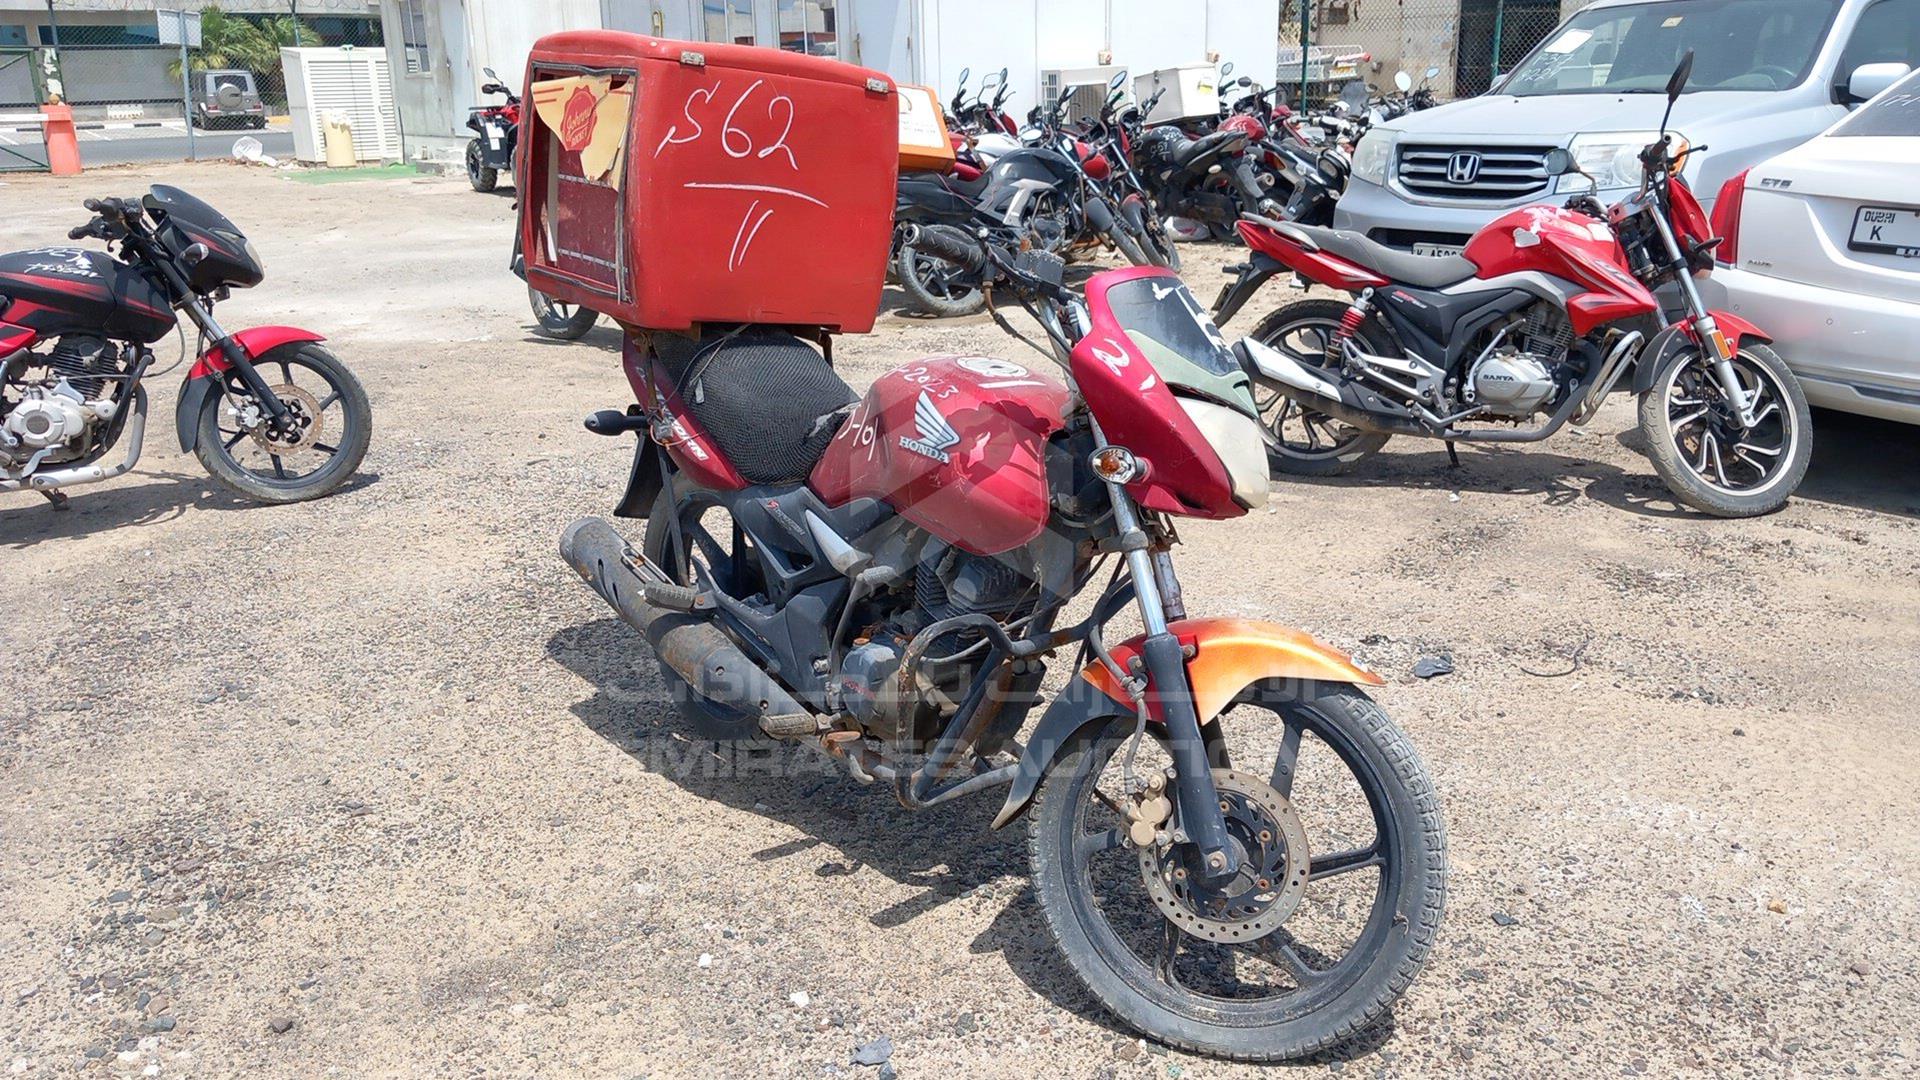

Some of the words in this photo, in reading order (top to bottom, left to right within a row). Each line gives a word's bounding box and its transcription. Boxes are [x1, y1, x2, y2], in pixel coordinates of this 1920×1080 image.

[1863, 210, 1896, 224] DUBAI
[1869, 225, 1883, 241] K
[1483, 374, 1514, 382] SANYA
[898, 434, 951, 465] HONDA
